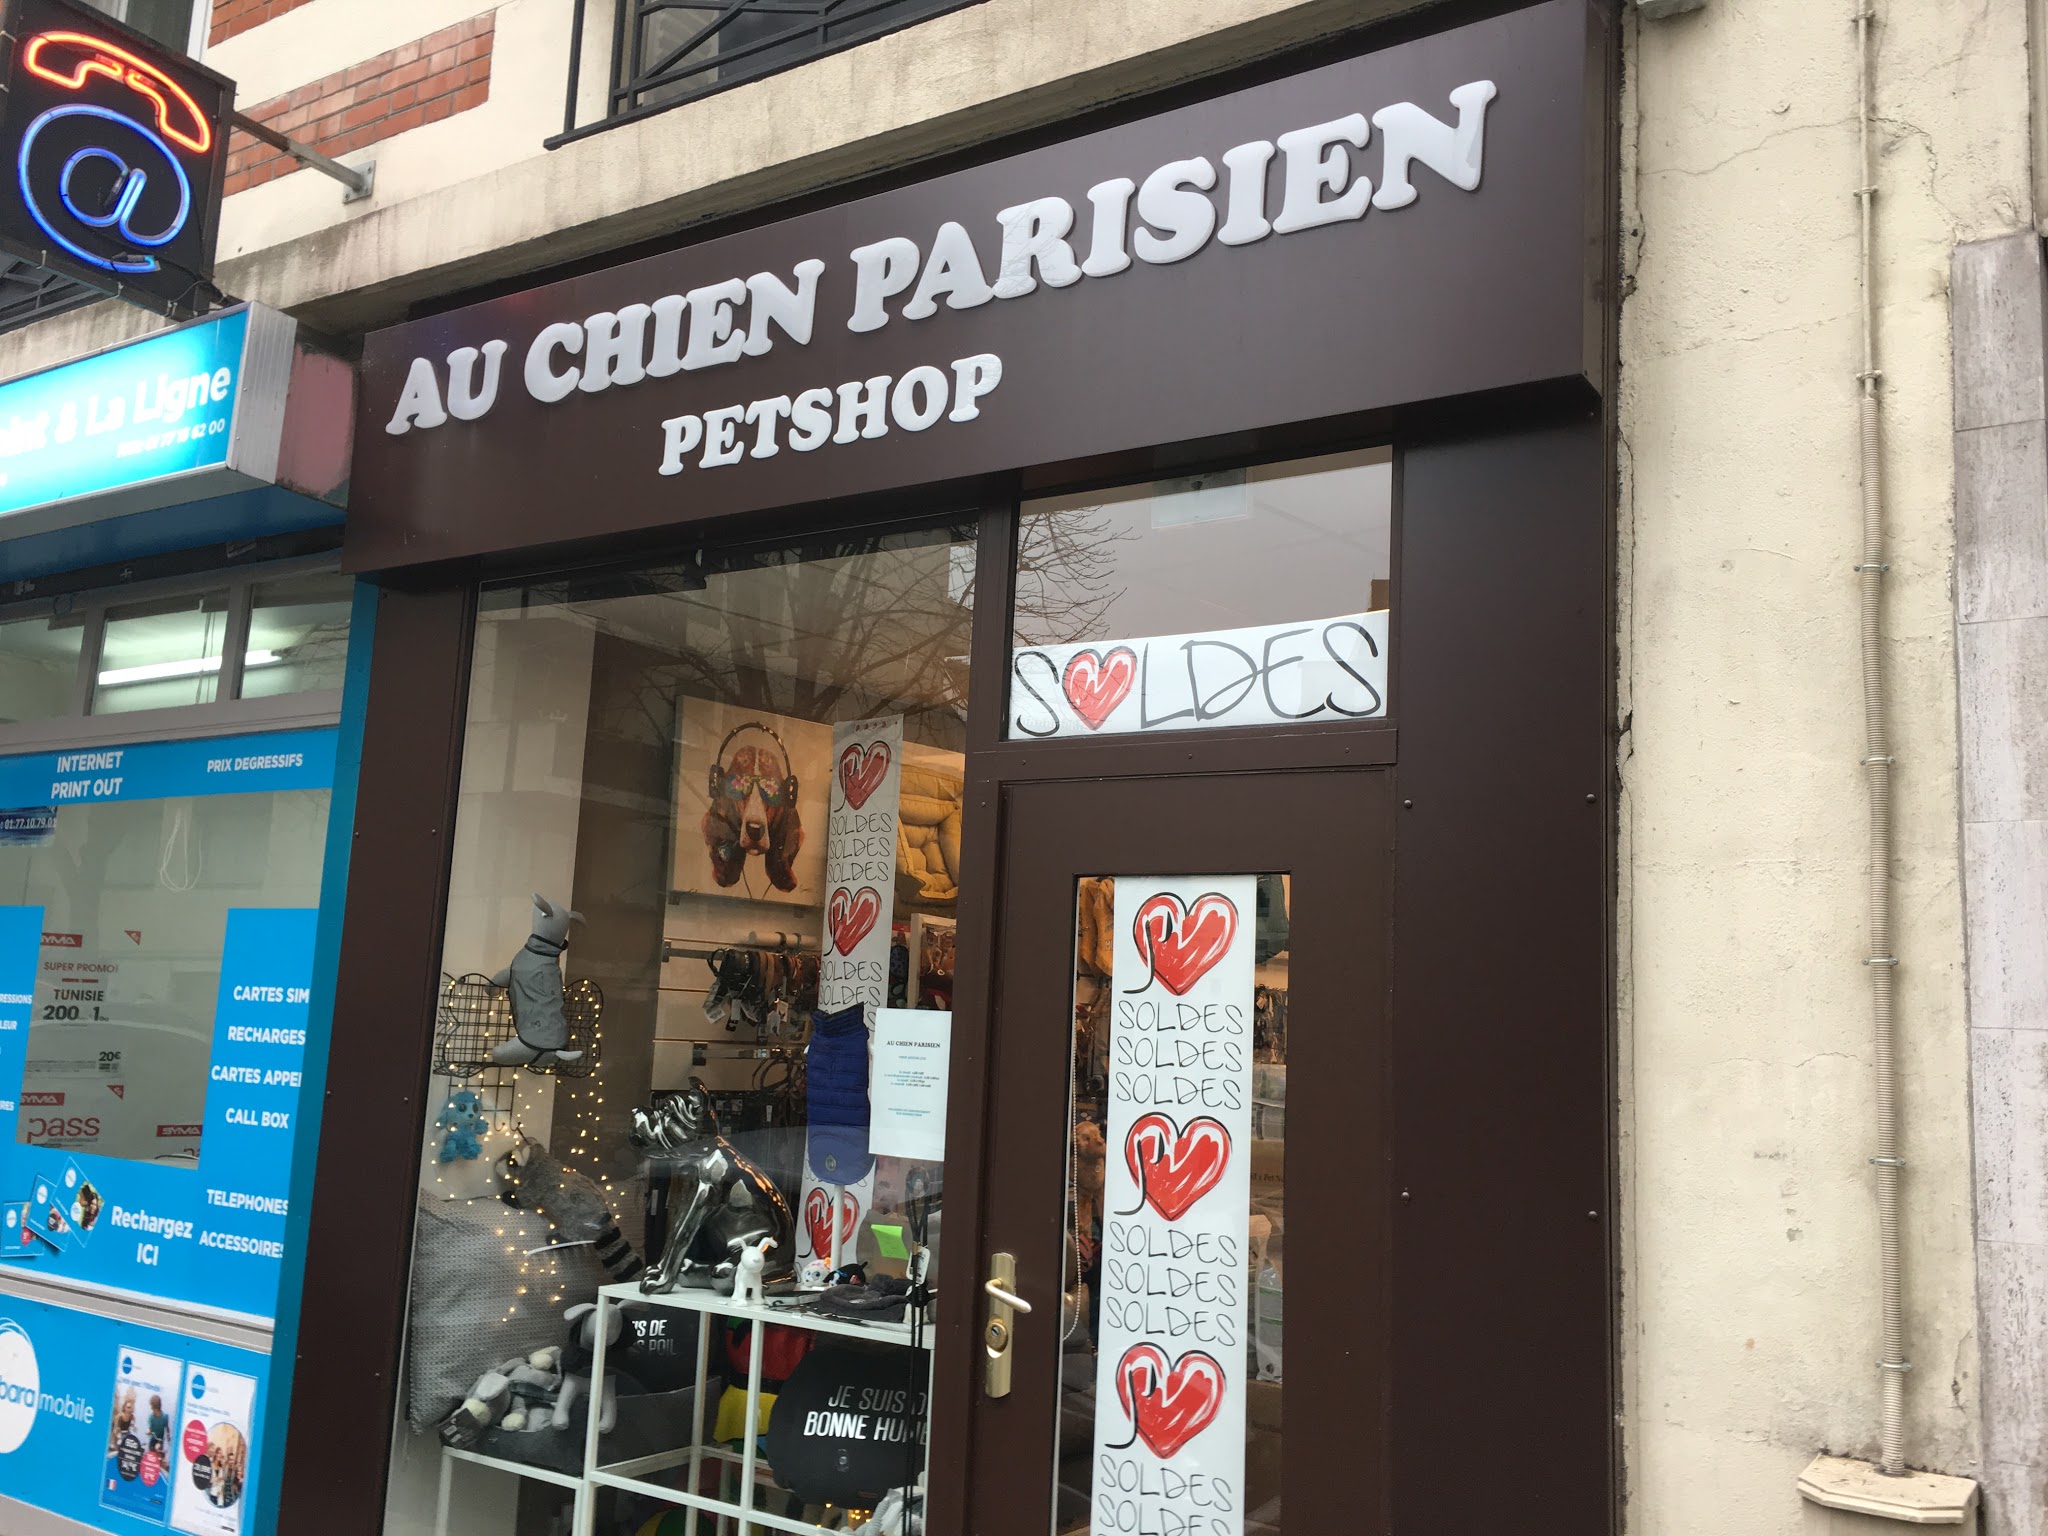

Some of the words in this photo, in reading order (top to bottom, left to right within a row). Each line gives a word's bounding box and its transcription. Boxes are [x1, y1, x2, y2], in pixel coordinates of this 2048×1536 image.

[385, 338, 507, 435] AU
[523, 258, 825, 403] CHIEN
[846, 79, 1497, 333] PARISIEN
[132, 366, 231, 424] Ligne
[658, 354, 1002, 476] PETSHOP
[56, 751, 124, 774] INTERNET
[206, 758, 233, 773] PRIX
[234, 753, 304, 771] DEGRESSIFS
[51, 780, 91, 799] PRINT
[93, 777, 123, 796] OUT
[830, 812, 892, 836] SOLDES
[828, 836, 891, 860] SOLDES
[827, 861, 889, 883] SOLDES
[43, 961, 75, 971] SUPER
[820, 960, 883, 982] SOLDES
[53, 988, 104, 1002] TUNISIE
[233, 985, 283, 1002] CARTES
[286, 987, 310, 1004] SIM
[43, 1004, 80, 1021] 200
[1118, 1000, 1243, 1034] SOLDES
[227, 1026, 307, 1046] RECHARGES
[914, 1041, 941, 1049] PARISIEN
[1116, 1036, 1242, 1072] SOLDES
[211, 1065, 262, 1084] CARTES
[1115, 1072, 1241, 1110] SOLDES
[225, 1107, 259, 1126] CALL
[261, 1111, 290, 1129] BOX
[26, 1117, 101, 1144] pass
[111, 1205, 194, 1239] Rechargez
[136, 1242, 159, 1267] ICI
[1109, 1221, 1238, 1267] SOLDES
[1107, 1259, 1237, 1307] SOLDES
[649, 1319, 668, 1337] DE
[1106, 1296, 1236, 1347] SOLDES
[38, 1393, 95, 1424] mobile
[828, 1385, 855, 1408] JE
[858, 1387, 907, 1414] SUIS
[803, 1411, 870, 1440] BONNE
[1100, 1453, 1233, 1512] SOLDES
